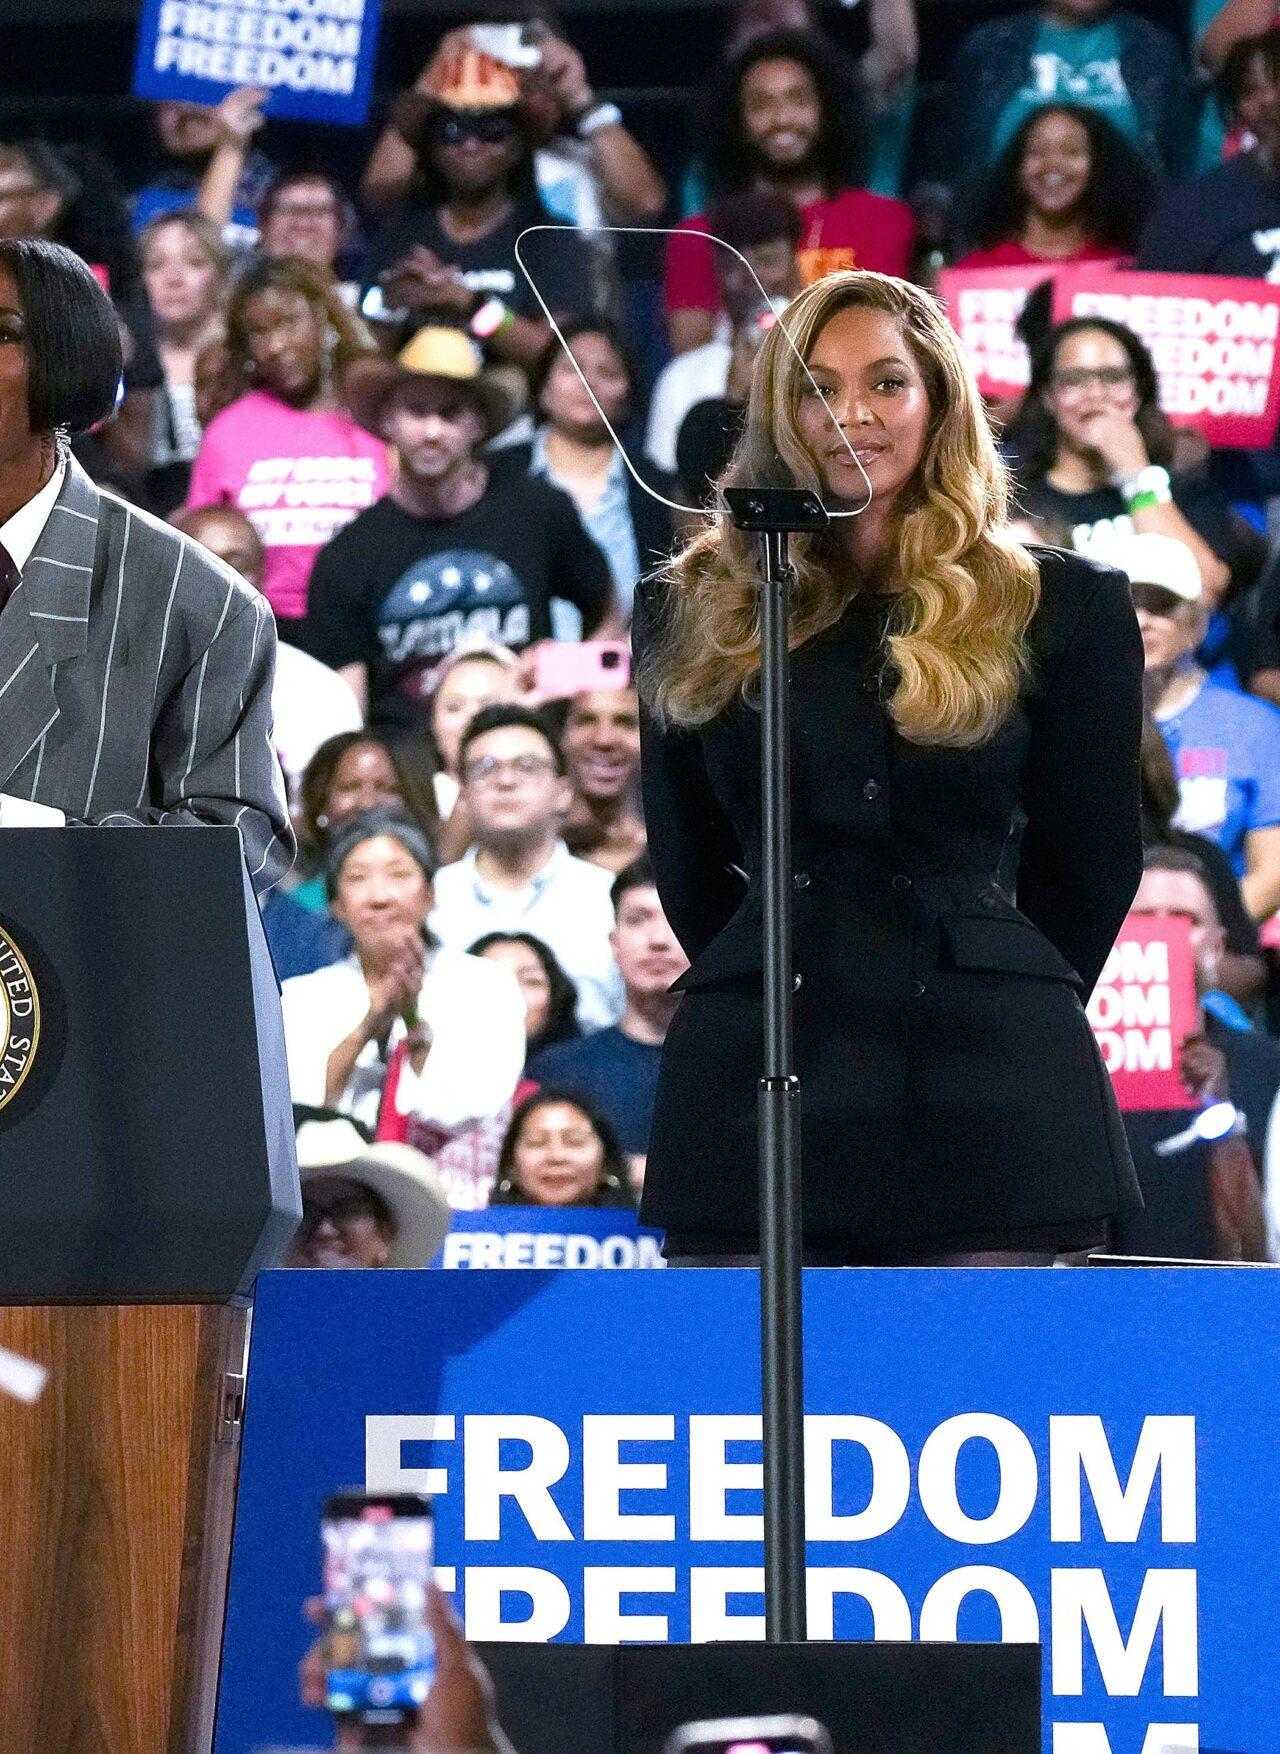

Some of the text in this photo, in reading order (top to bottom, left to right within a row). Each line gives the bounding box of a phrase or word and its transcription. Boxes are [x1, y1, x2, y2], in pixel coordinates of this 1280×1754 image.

[158, 1, 363, 57] FREEDOM
[153, 36, 358, 95] FREEDOM
[365, 1413, 1198, 1544] FREEDOM
